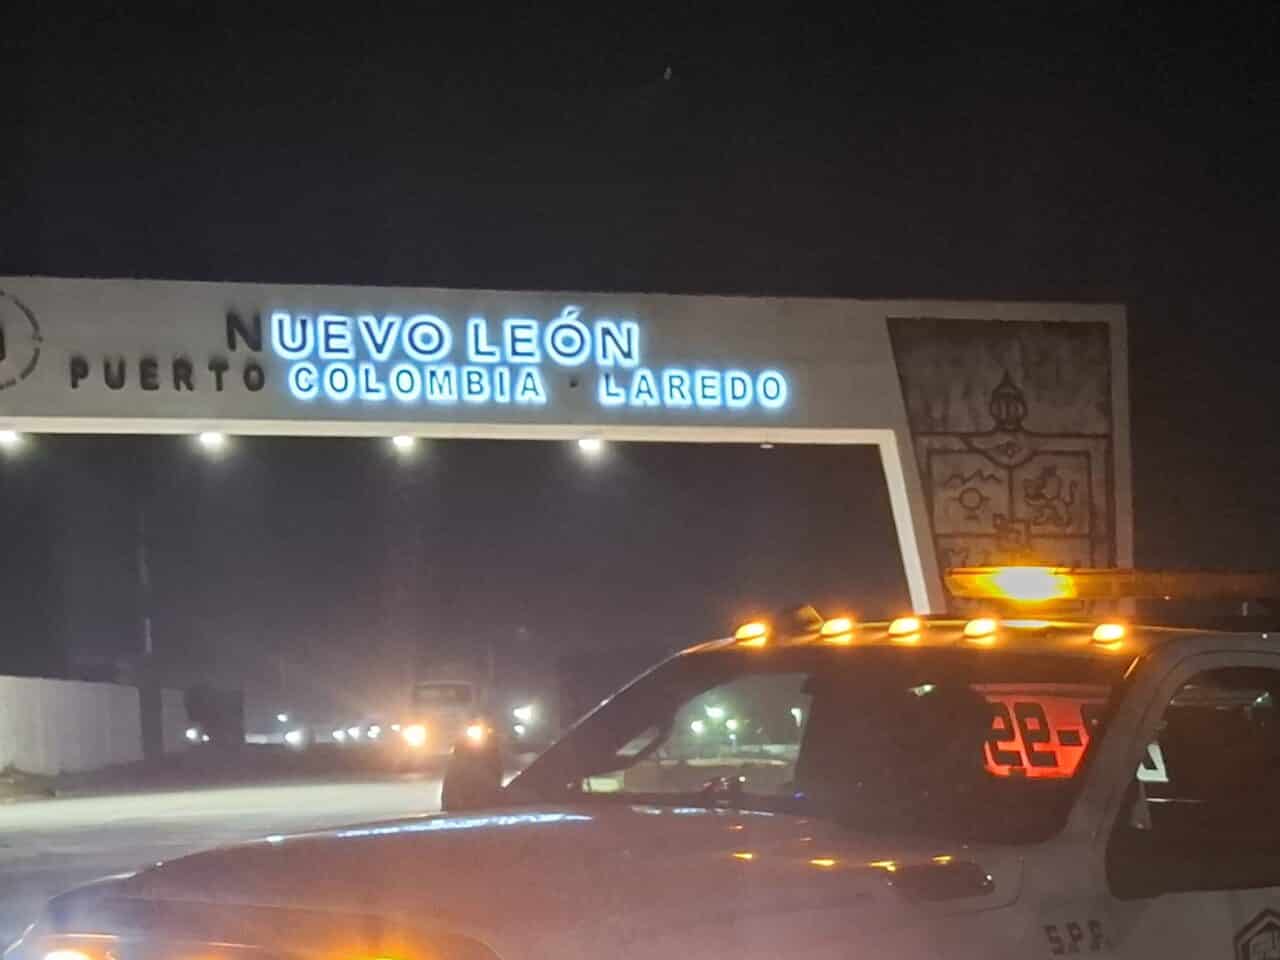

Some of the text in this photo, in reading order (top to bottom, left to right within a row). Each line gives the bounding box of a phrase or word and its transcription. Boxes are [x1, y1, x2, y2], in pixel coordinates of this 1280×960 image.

[225, 306, 636, 363] NUEVO LEÓN
[69, 355, 785, 405] PUERTO COLOMBIA LAREDO
